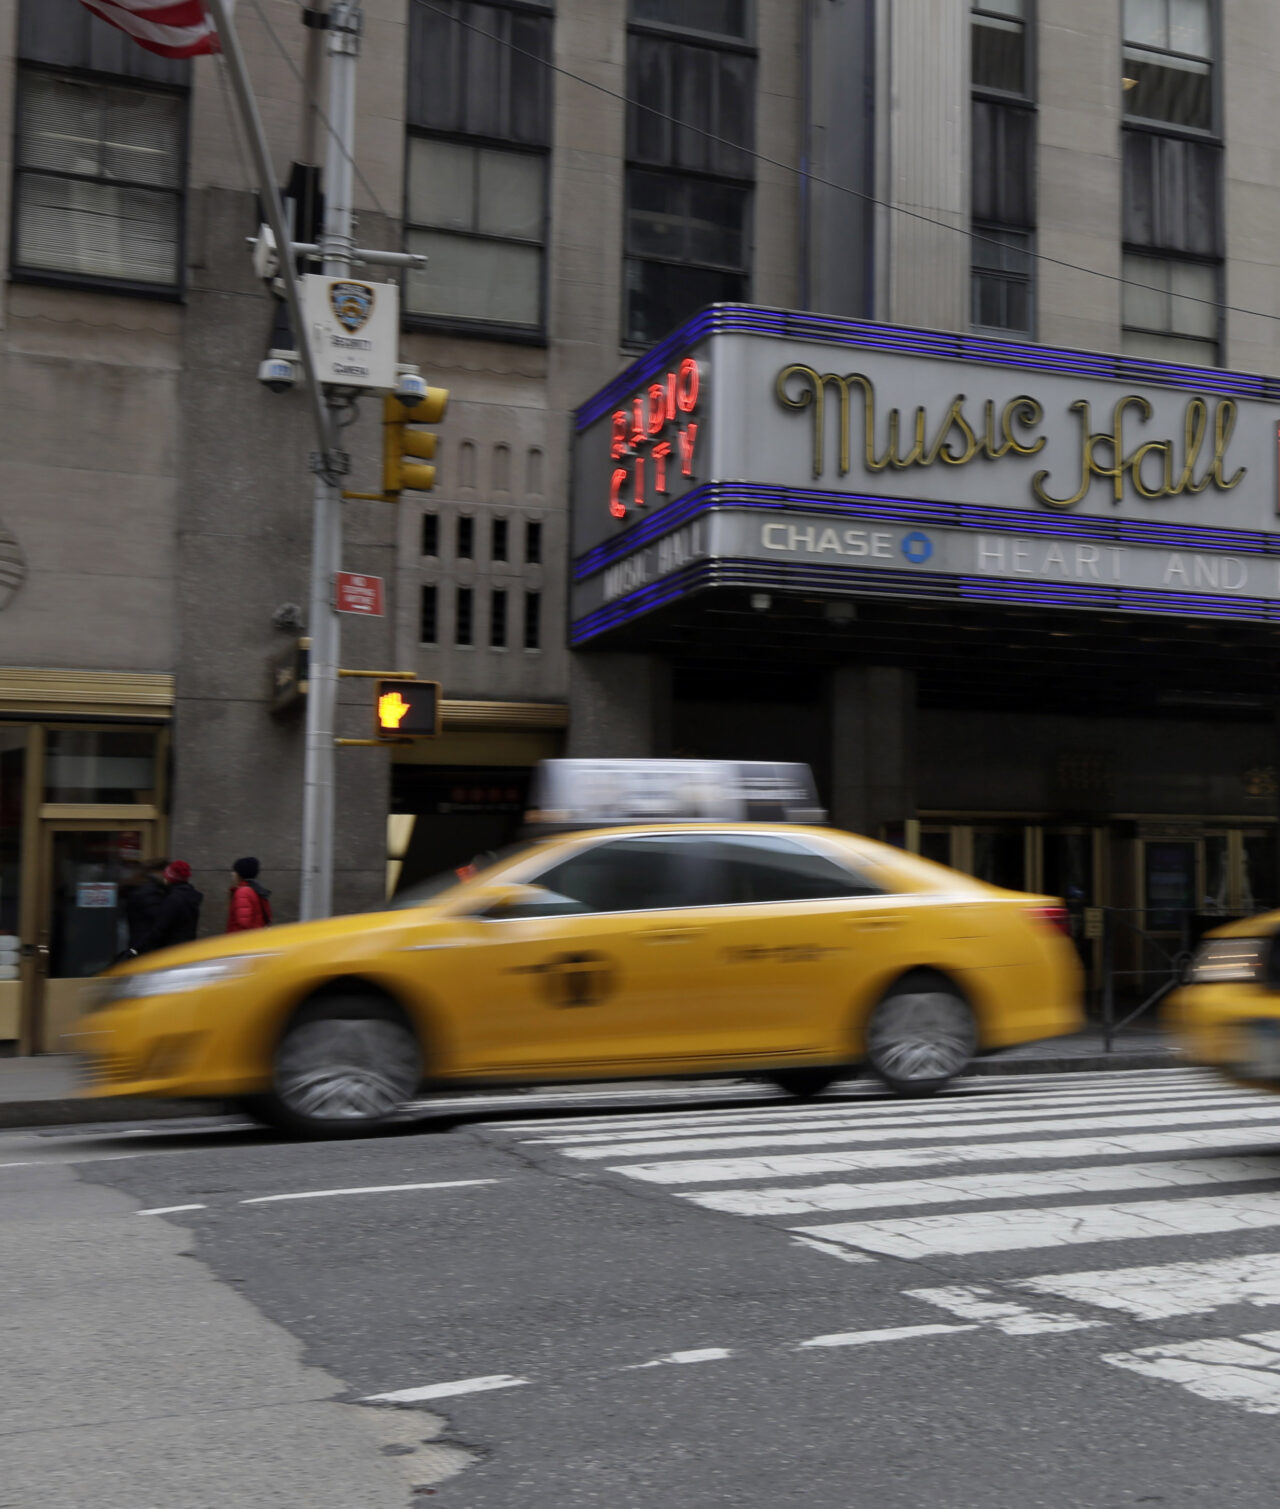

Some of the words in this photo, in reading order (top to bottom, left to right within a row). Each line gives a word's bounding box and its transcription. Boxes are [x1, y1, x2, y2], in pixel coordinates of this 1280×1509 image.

[611, 358, 699, 460] RADIO
[775, 363, 1048, 479] Music
[1033, 395, 1248, 508] Hall
[610, 423, 698, 518] CITY
[761, 522, 894, 559] CHASE
[976, 533, 1127, 583] HEART
[1162, 551, 1249, 591] AND
